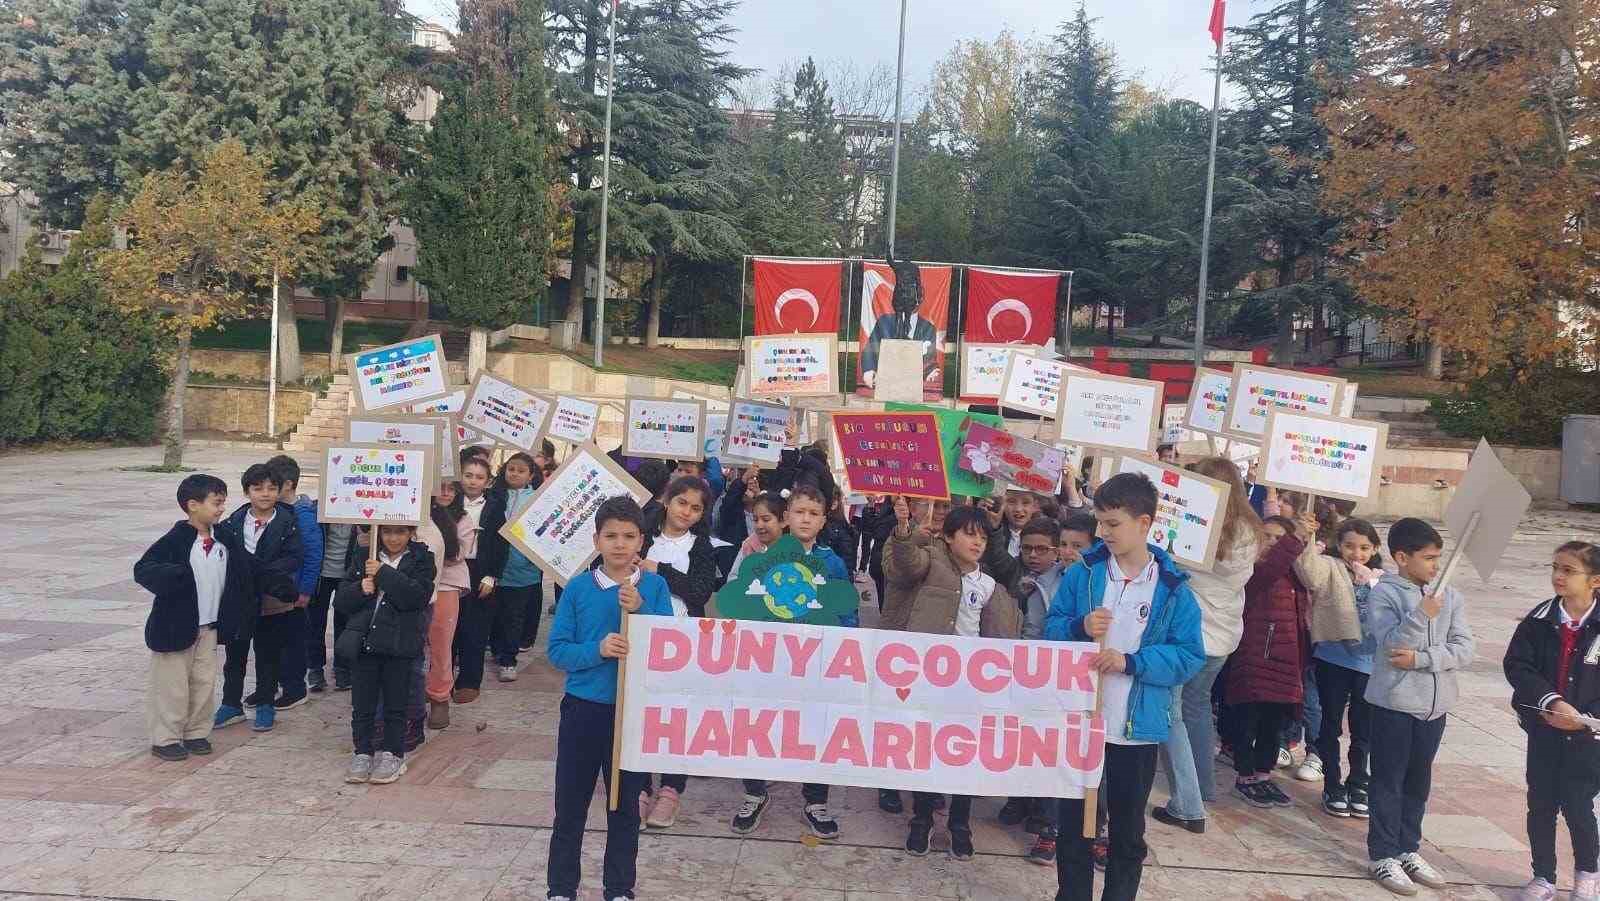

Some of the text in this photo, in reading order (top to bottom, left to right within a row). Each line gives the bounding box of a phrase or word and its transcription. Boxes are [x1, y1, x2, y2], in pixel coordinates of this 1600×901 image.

[634, 417, 694, 433] SAĞLIK HAKKI
[843, 422, 864, 434] BİR
[350, 463, 405, 475] ÇOCUK İŞÇİ
[648, 618, 1098, 702] DÜNYA ÇOCUK
[641, 706, 1105, 773] HAKLARI GÜNÜ
